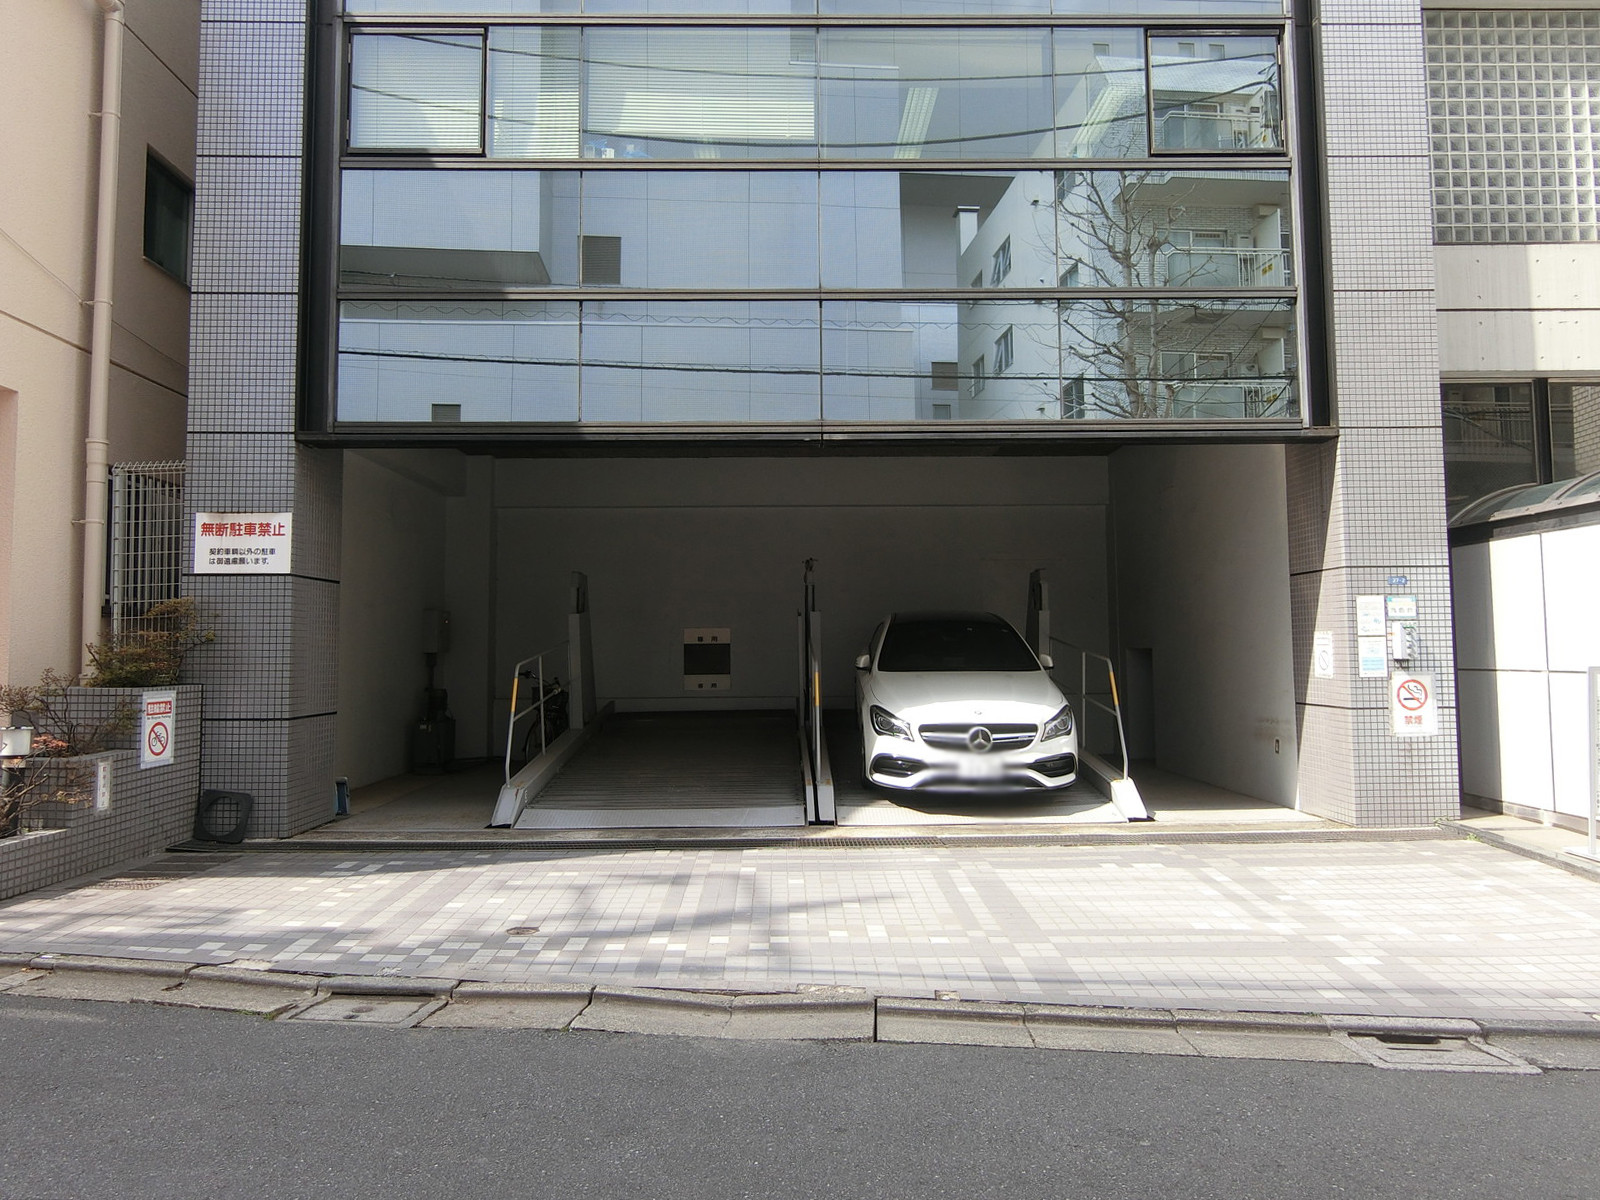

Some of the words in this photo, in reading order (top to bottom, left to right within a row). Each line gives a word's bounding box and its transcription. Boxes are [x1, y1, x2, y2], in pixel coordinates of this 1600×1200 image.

[201, 522, 286, 537] 無断駐車禁止
[1404, 715, 1423, 725] 禁煙
